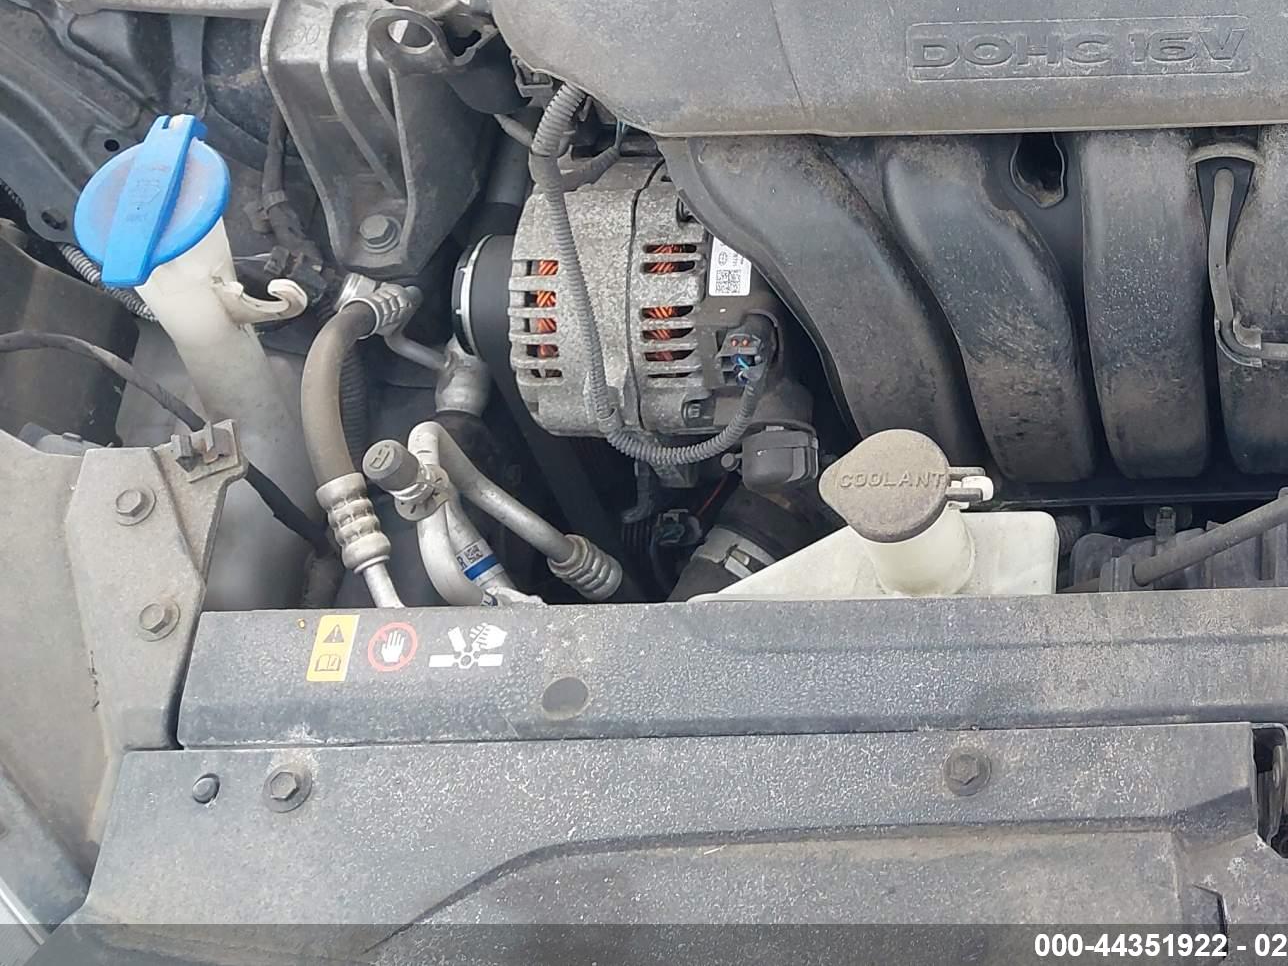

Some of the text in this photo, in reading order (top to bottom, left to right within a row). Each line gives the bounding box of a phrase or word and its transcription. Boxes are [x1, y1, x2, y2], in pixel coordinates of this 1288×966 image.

[911, 27, 1247, 68] DOHC 16V
[839, 470, 945, 489] COOLANT
